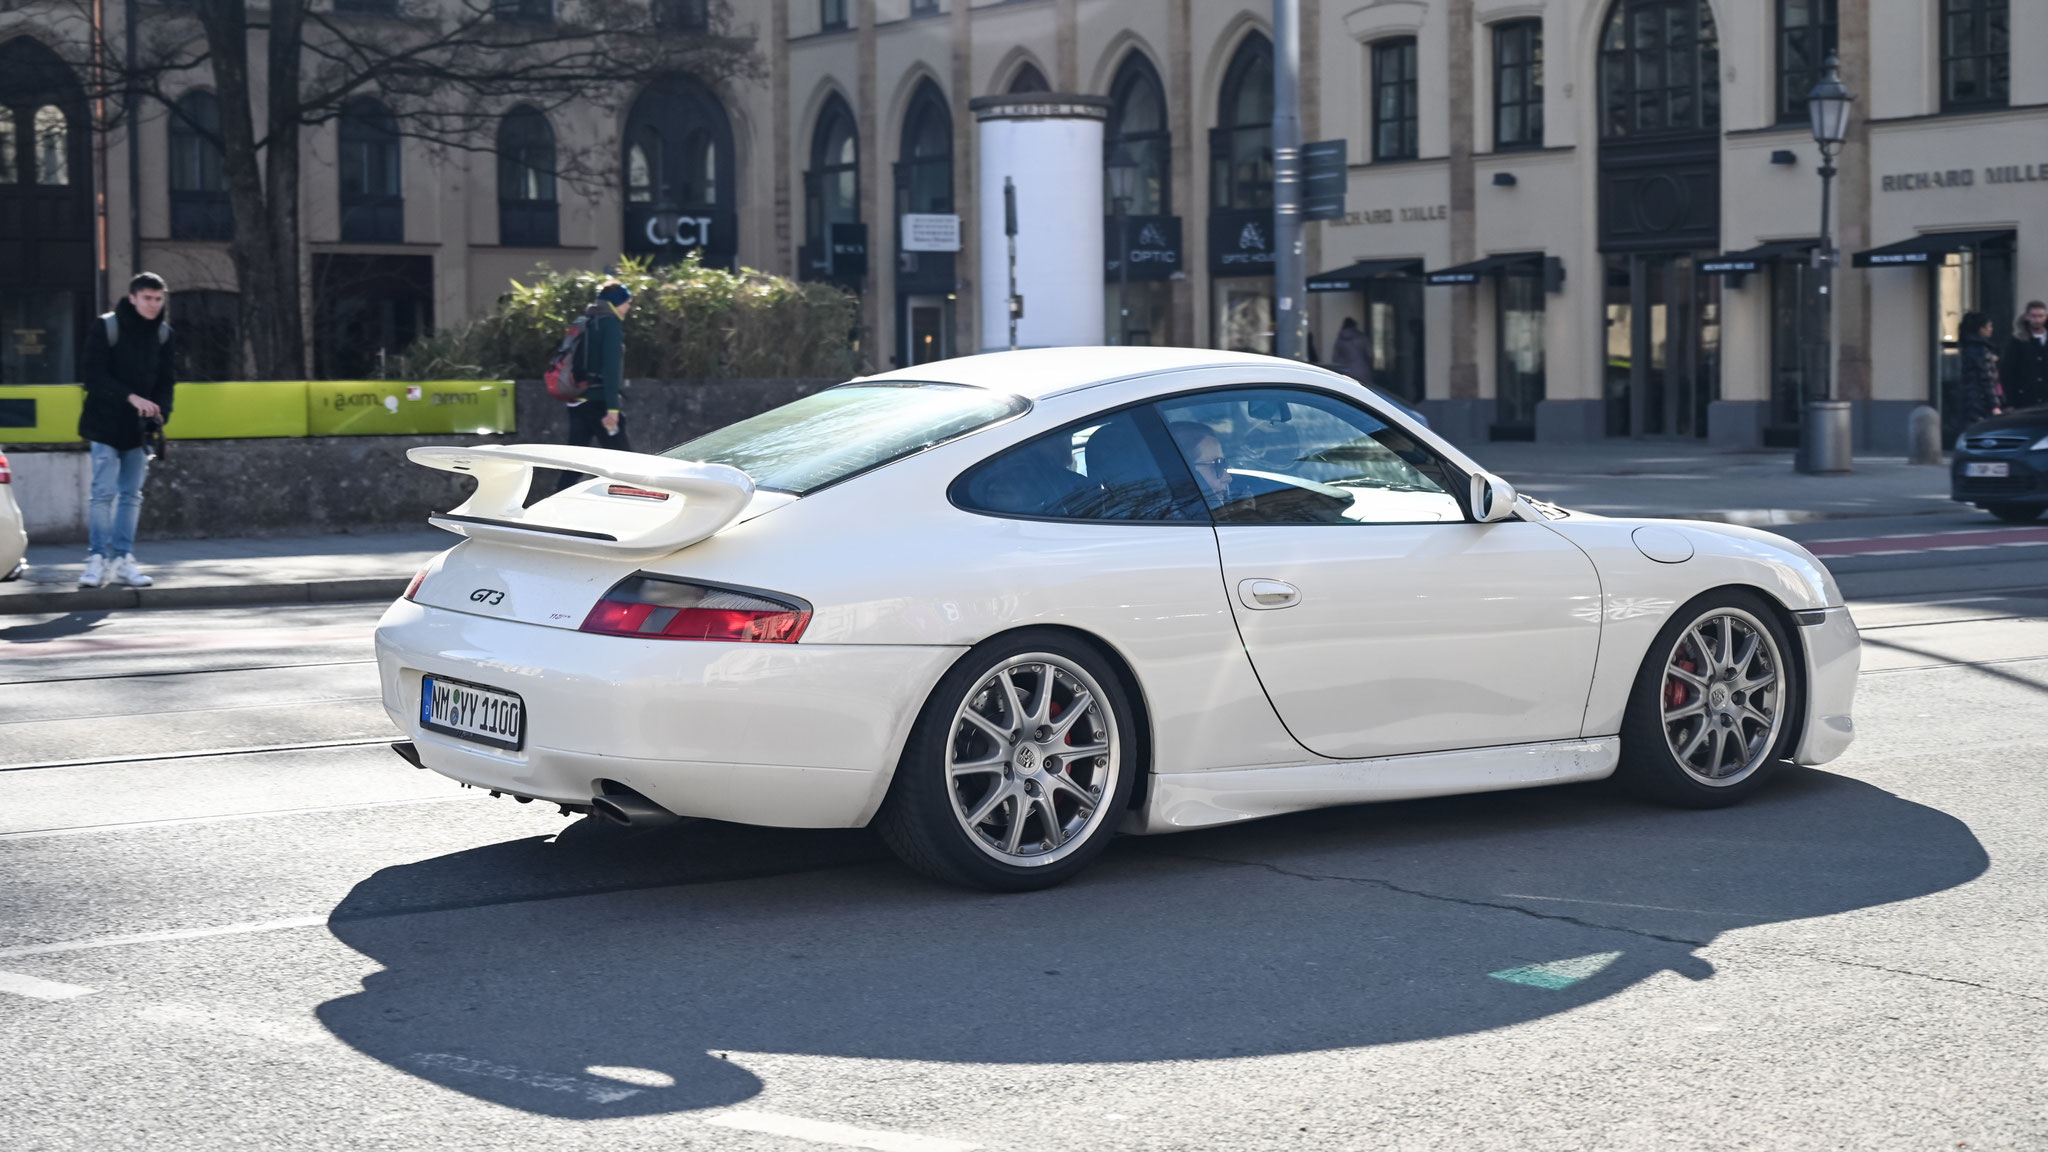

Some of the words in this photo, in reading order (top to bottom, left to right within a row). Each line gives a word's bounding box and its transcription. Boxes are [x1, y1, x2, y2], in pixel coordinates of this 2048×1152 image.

[1882, 168, 1975, 192] RICHARD
[1985, 163, 2048, 184] MILLE
[1130, 250, 1176, 263] OPTIC
[469, 588, 505, 606] GT3
[431, 685, 450, 721] NM
[460, 691, 479, 728] YY
[479, 697, 518, 737] 1100
